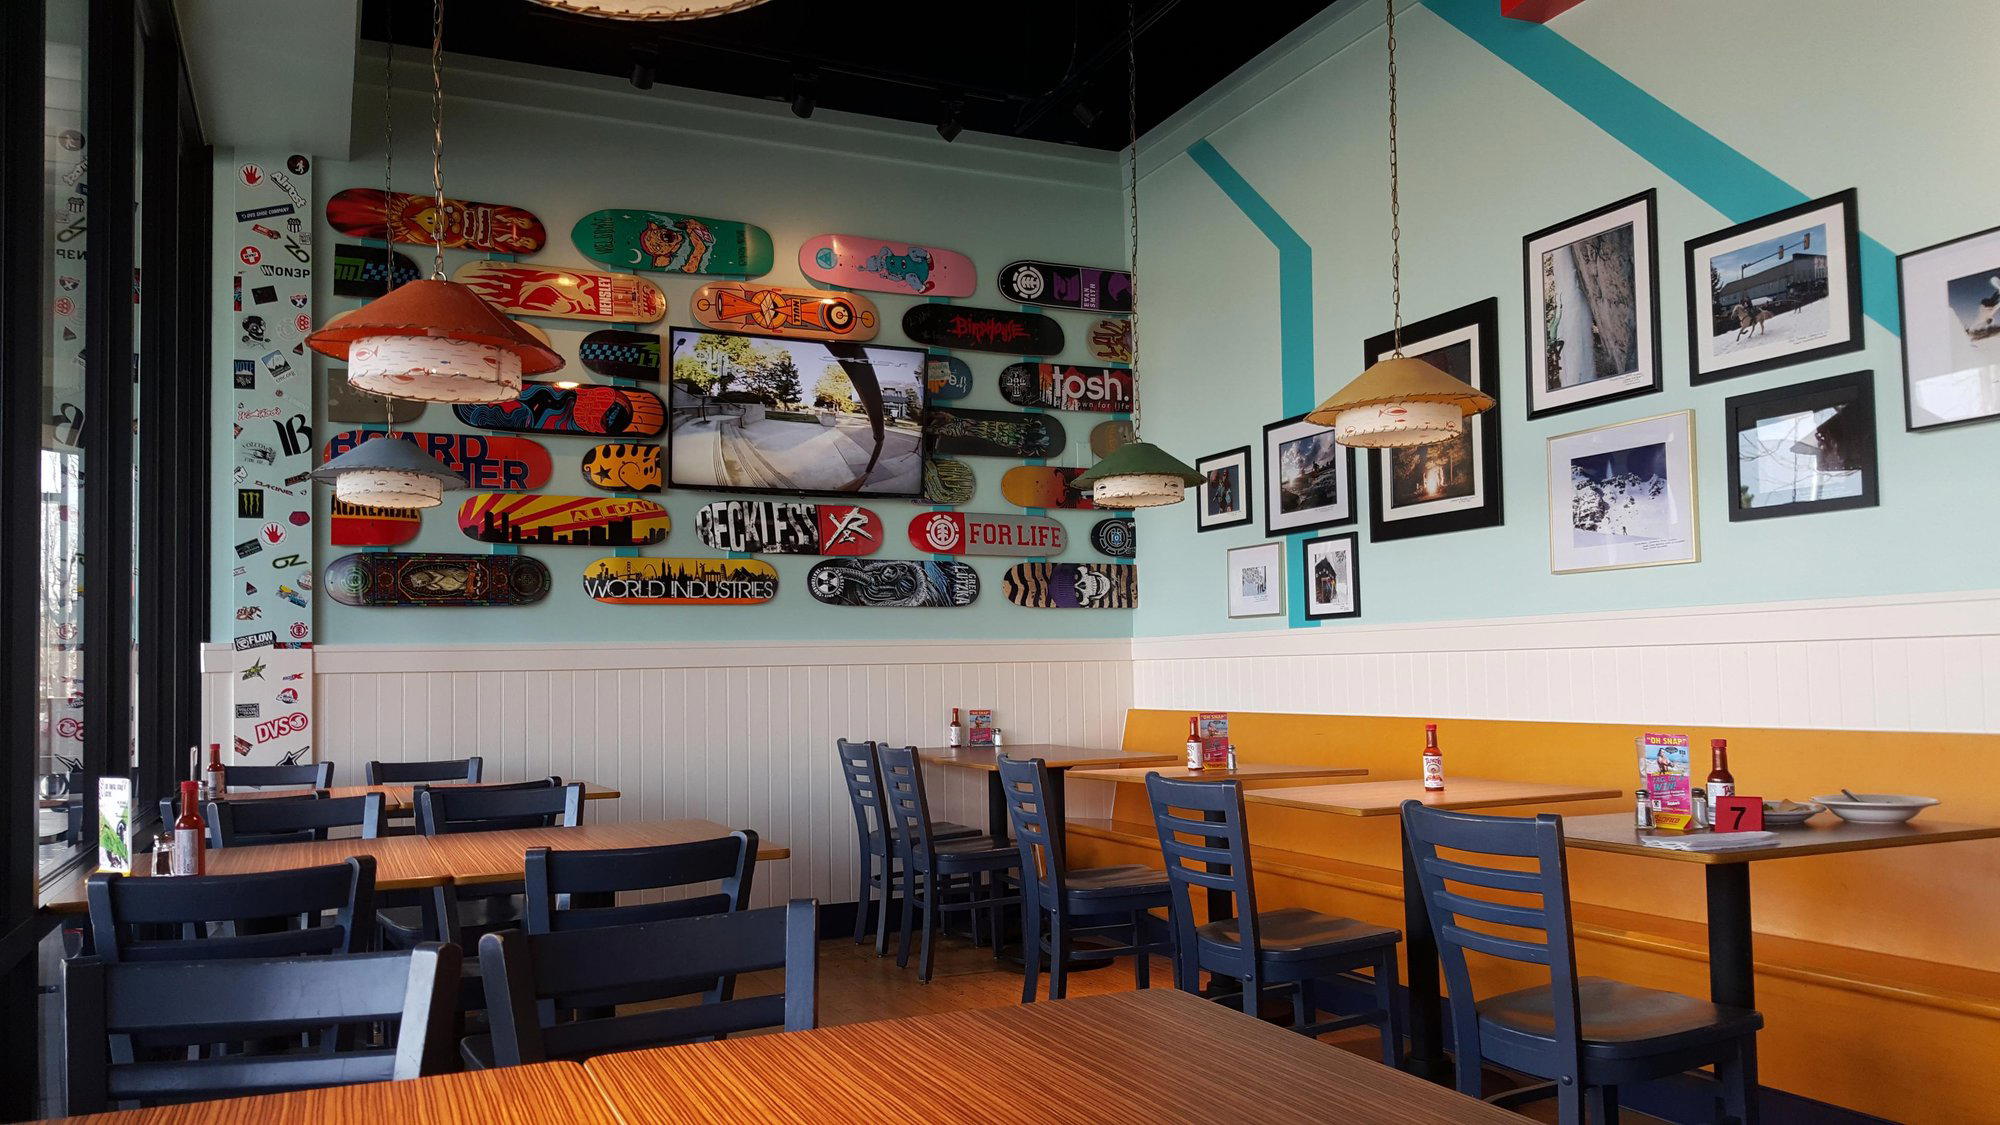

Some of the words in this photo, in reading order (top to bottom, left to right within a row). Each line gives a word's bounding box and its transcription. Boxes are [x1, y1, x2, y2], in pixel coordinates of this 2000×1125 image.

[331, 432, 488, 465] BRD
[697, 502, 818, 553] RECKLESS
[969, 523, 1013, 545] FOR
[1017, 525, 1062, 548] LIFE
[585, 580, 665, 598] WORLD
[671, 581, 774, 599] INDUSTRIES
[968, 573, 977, 595] GREG
[249, 632, 273, 645] FLOW
[255, 717, 292, 744] DVS
[1730, 806, 1747, 830] 7
